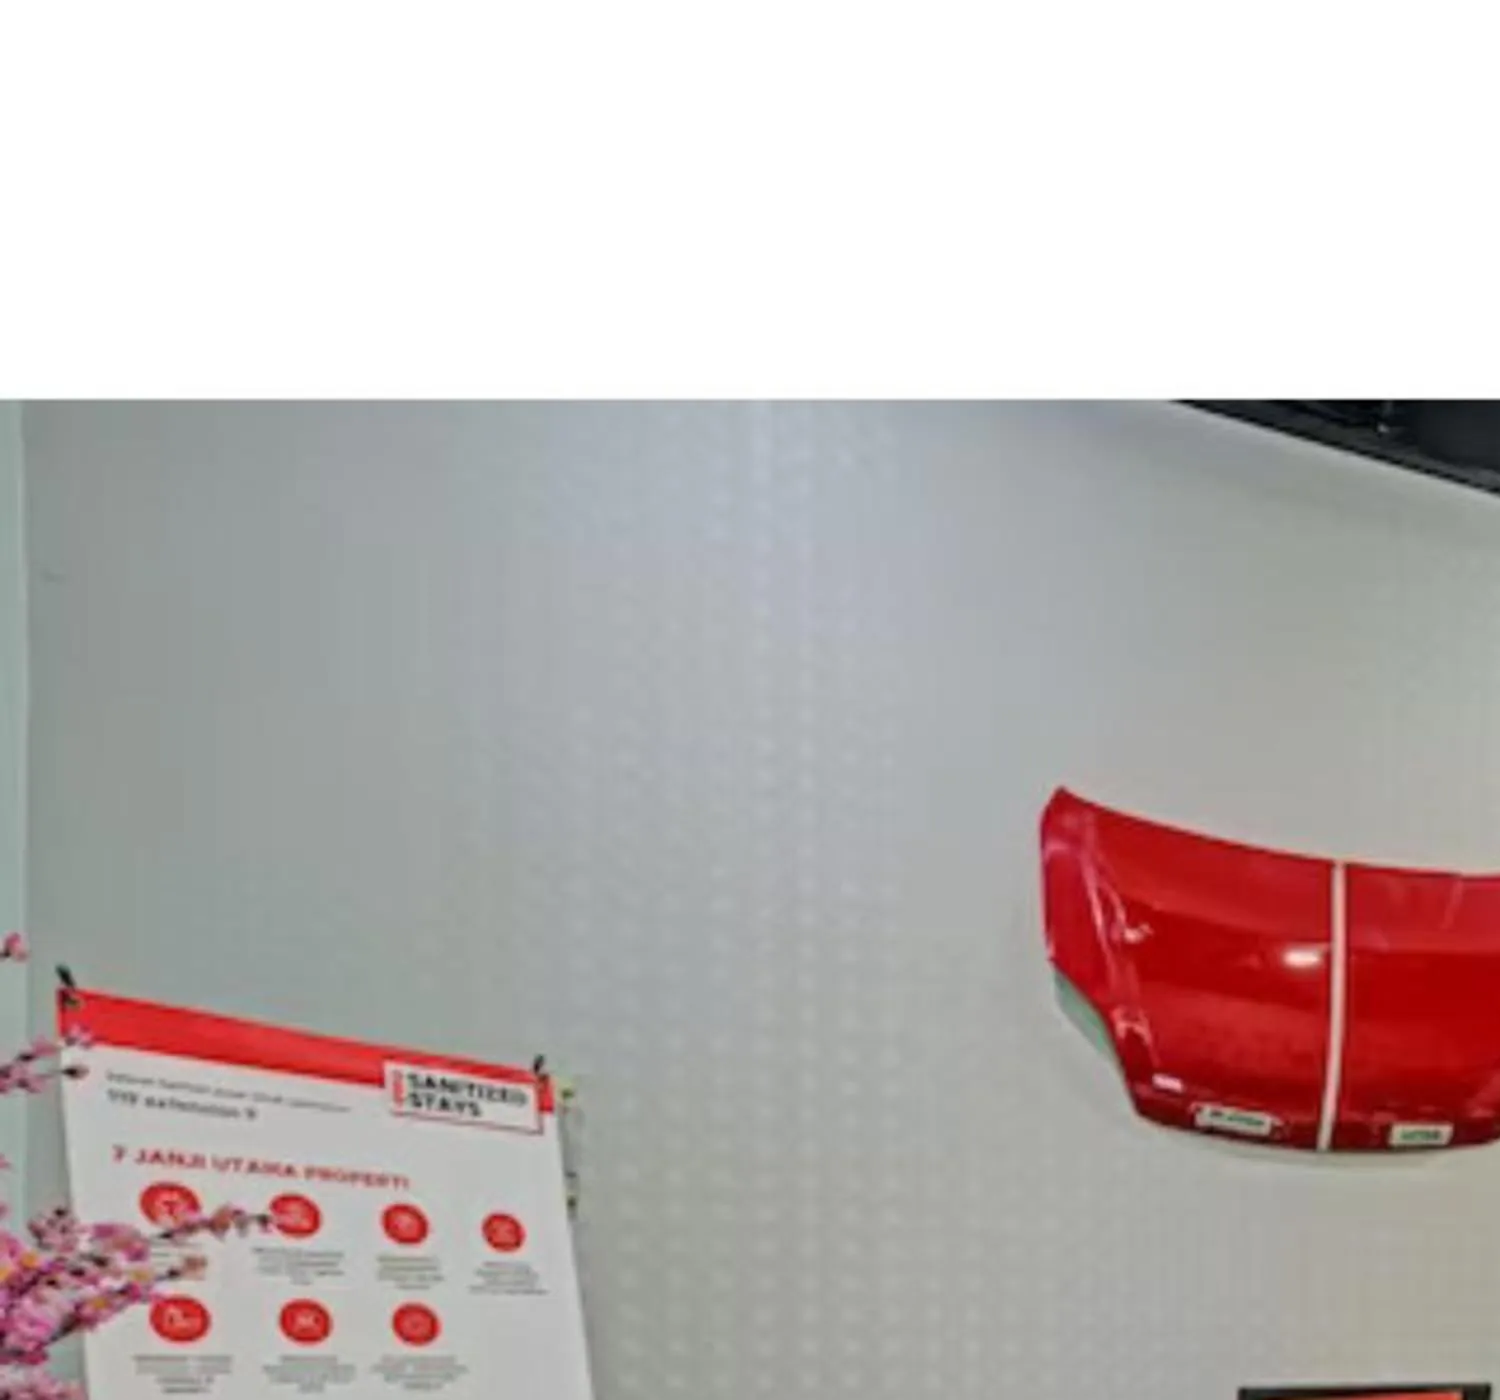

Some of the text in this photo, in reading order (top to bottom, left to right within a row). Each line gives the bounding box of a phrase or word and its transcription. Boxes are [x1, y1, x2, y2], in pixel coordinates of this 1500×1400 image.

[407, 1072, 528, 1107] SANITIZED
[408, 1091, 482, 1118] STAYS
[135, 1147, 206, 1171] JANJI
[209, 1155, 297, 1180] UTAMA
[301, 1164, 412, 1191] PROPERTI
